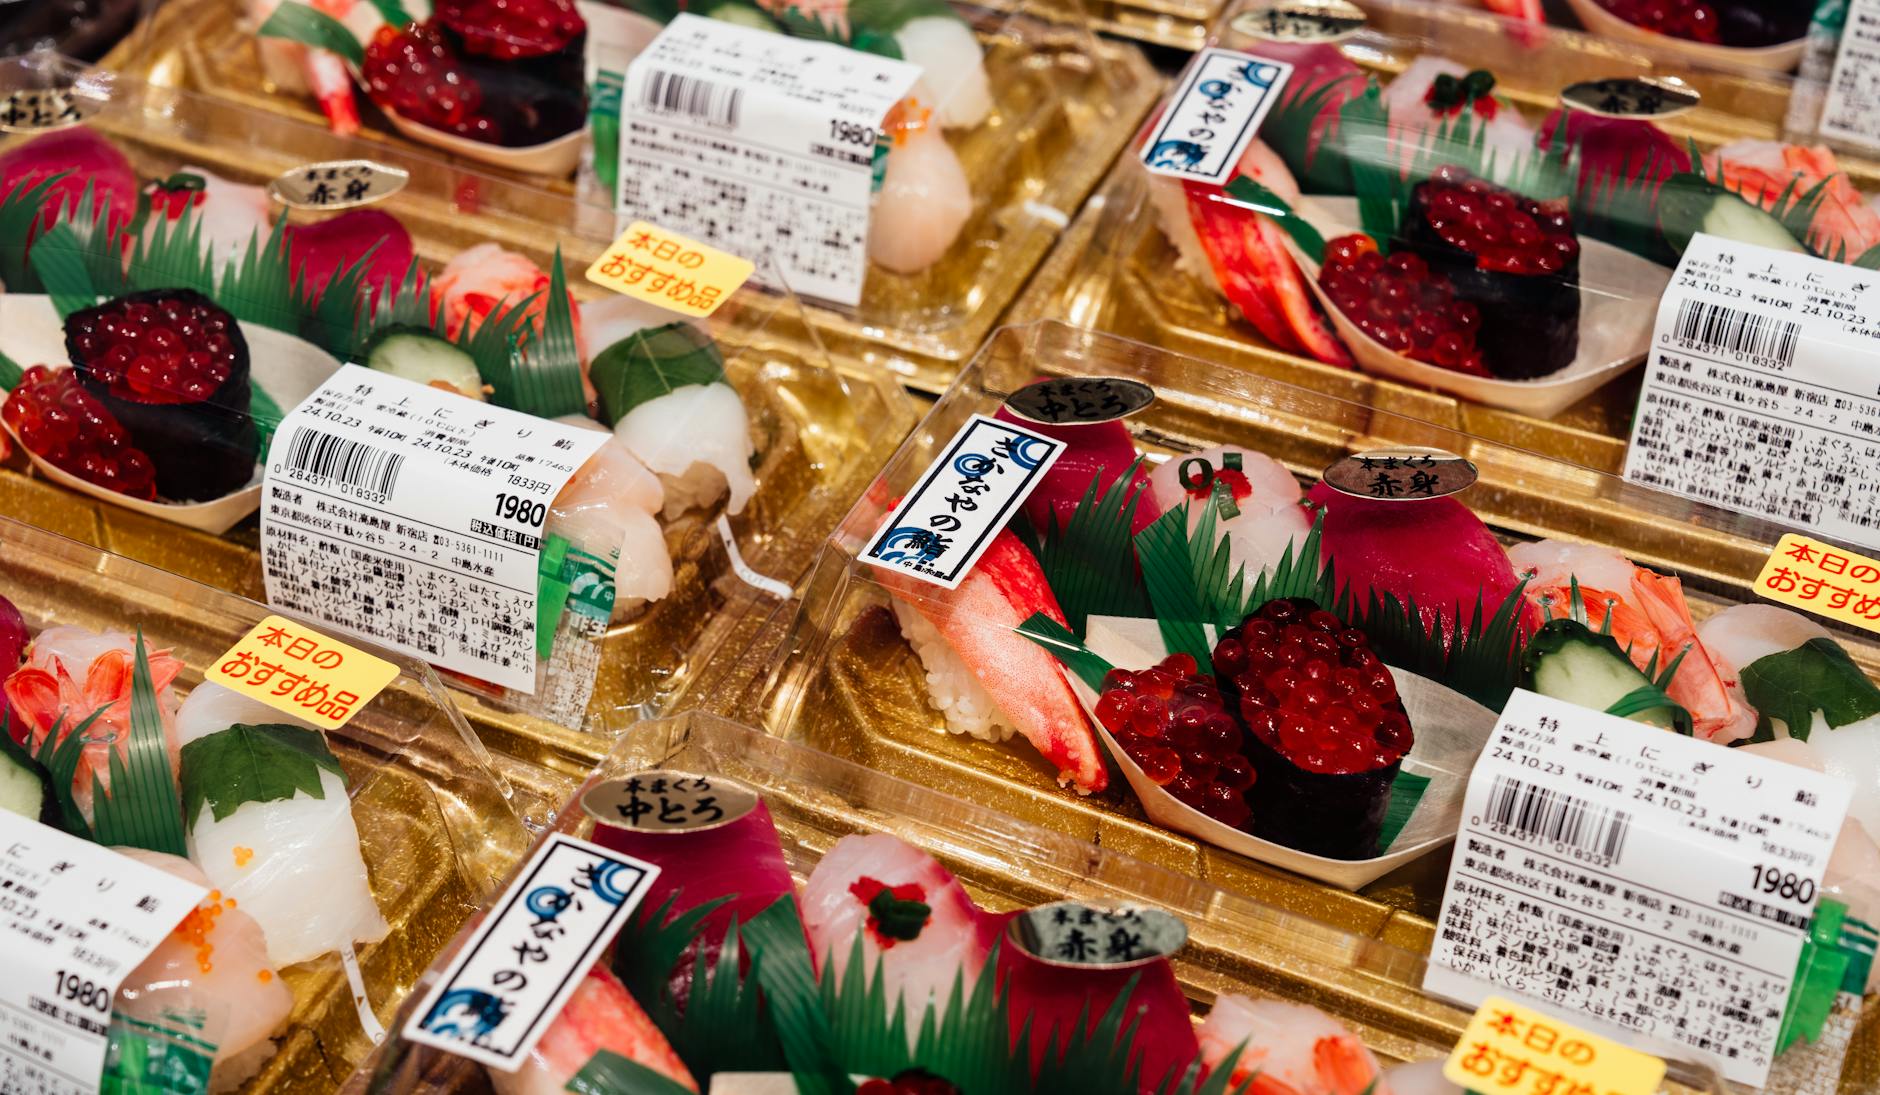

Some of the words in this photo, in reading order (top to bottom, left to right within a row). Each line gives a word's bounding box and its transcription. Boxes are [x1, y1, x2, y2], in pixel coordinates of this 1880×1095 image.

[828, 118, 876, 148] 1980
[305, 178, 372, 207] 赤身
[626, 230, 707, 271] 本日の
[598, 252, 723, 312] おすすめ品
[1676, 276, 1743, 299] 24.10.23
[1800, 304, 1867, 326] 24.10.23
[1661, 333, 1670, 344] 0
[1678, 338, 1726, 357] 284371
[1735, 352, 1786, 372] 018332
[1657, 354, 1693, 374] 製造者
[1794, 388, 1829, 408] 新宿店
[1036, 395, 1129, 422] 中とろ
[300, 403, 364, 429] 24.10.23
[410, 436, 474, 459] 24.10.23
[1360, 454, 1437, 472] 本まぐろ
[1367, 469, 1440, 497] 赤身
[273, 463, 281, 475] 0
[288, 467, 333, 489] 284371
[340, 482, 387, 506] 018332
[270, 486, 303, 506] 製造者
[395, 522, 429, 542] 新宿店
[494, 491, 547, 529] 1980
[1784, 542, 1880, 584] 本日の
[256, 626, 344, 670] 本日の
[220, 650, 360, 721] おすすめ品
[622, 775, 713, 796] 本まぐろ
[1490, 746, 1566, 777] 24.10.23
[1632, 786, 1708, 819] 24.10.23
[615, 795, 724, 827] 中とろ
[1466, 837, 1507, 862] 製造者
[1469, 814, 1481, 828] 0
[1488, 820, 1545, 848] 284371
[1554, 839, 1612, 869] 018332
[1750, 862, 1815, 905] 1980
[1056, 927, 1143, 962] 赤身
[54, 968, 111, 1014] 1980
[1485, 1009, 1598, 1067] 本日の
